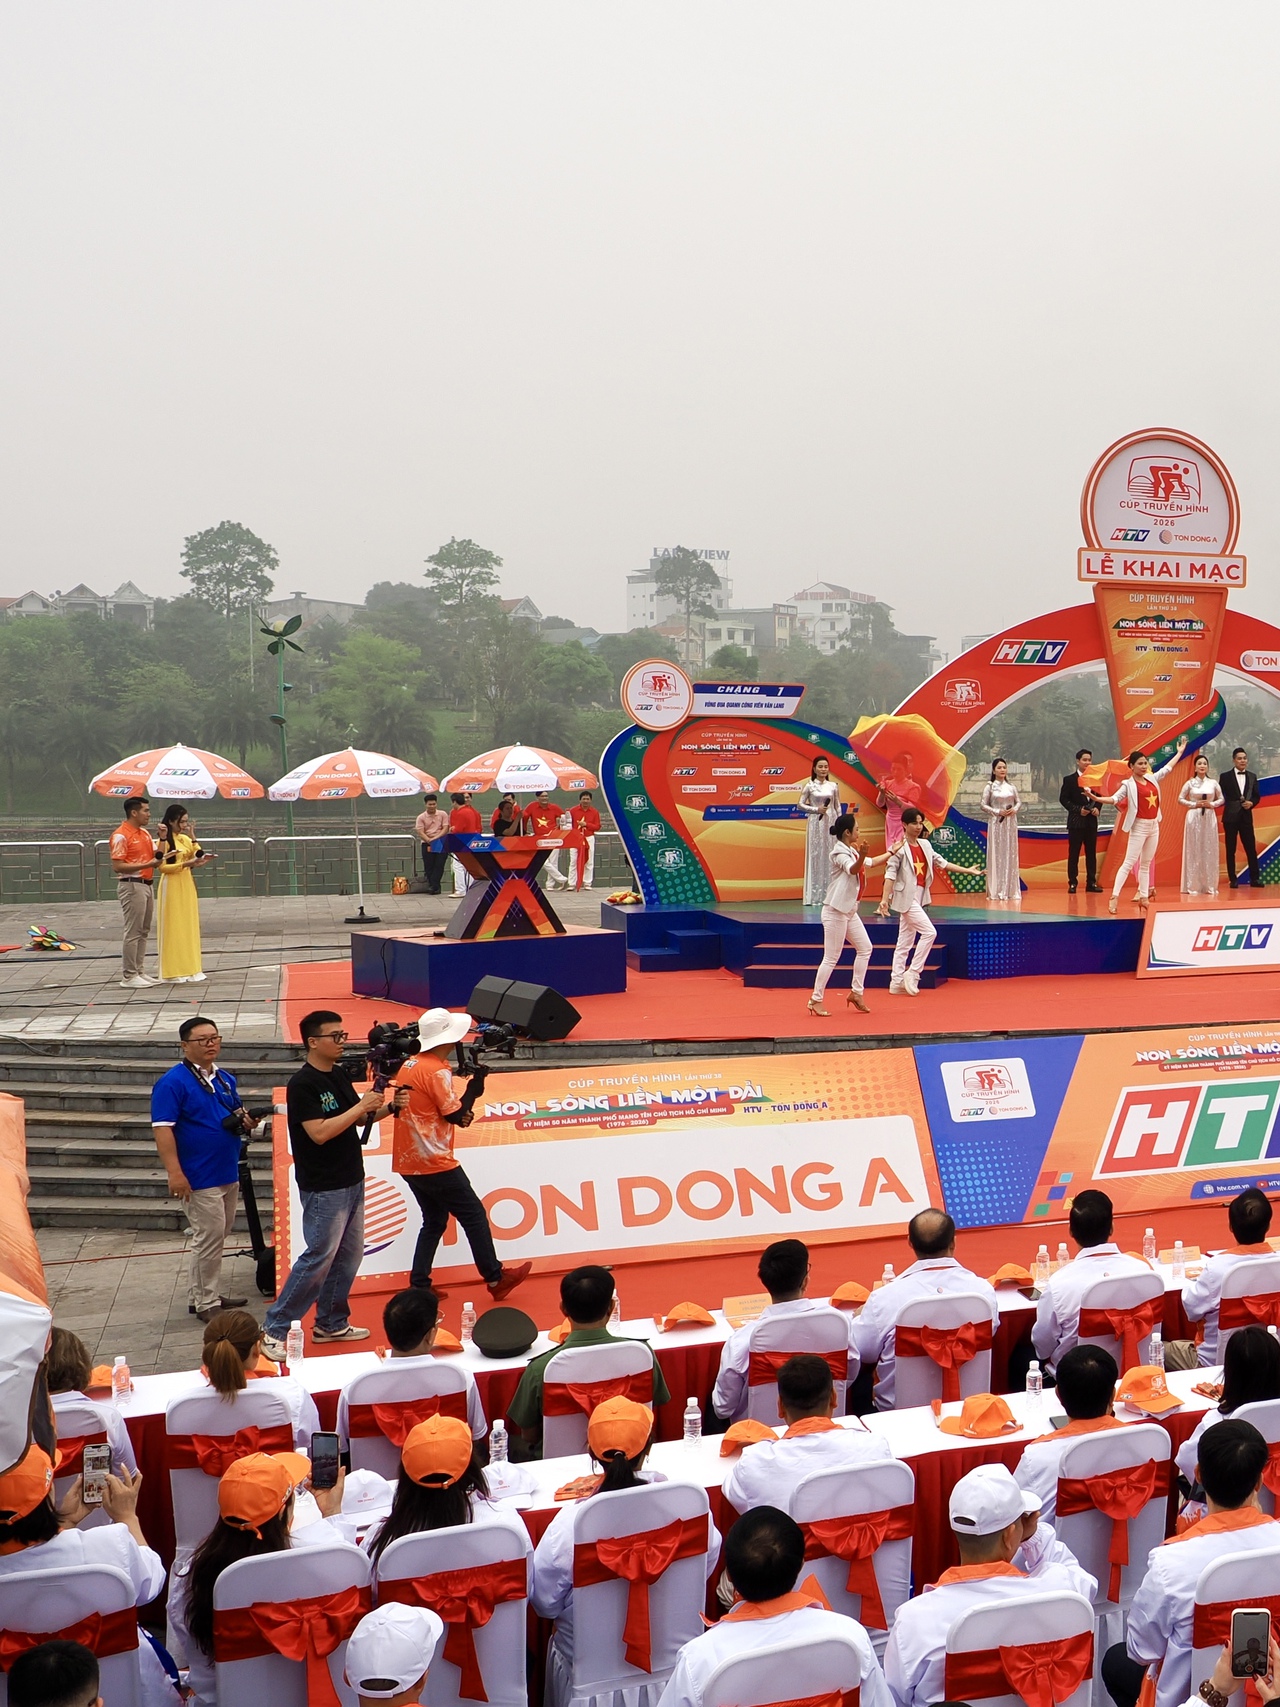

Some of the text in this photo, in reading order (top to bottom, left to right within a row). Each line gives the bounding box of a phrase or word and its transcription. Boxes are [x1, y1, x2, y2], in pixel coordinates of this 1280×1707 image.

[1120, 500, 1140, 508] CÚP
[1186, 504, 1208, 513] HÌNH
[1112, 530, 1149, 542] HTV
[1086, 553, 1240, 582] LỄ KHAI MẠC
[1138, 620, 1156, 628] SÔNG
[995, 642, 1065, 661] HTV
[1255, 656, 1277, 666] TON
[110, 786, 132, 794] HTV
[320, 788, 346, 796] HTV
[1136, 1050, 1172, 1062] NON
[1176, 1045, 1218, 1060] SÔNG
[1222, 1040, 1254, 1056] LIỀN
[568, 1078, 594, 1089] CÚP
[652, 1072, 682, 1082] HÌNH
[484, 1080, 764, 1117] NON SÔNG LIỀN MỘT DẢI
[744, 1106, 762, 1114] HTV
[960, 1108, 984, 1116] HTV
[618, 1160, 843, 1227] DONG
[858, 1156, 915, 1207] A
[1216, 1183, 1250, 1192] htv.com.vn
